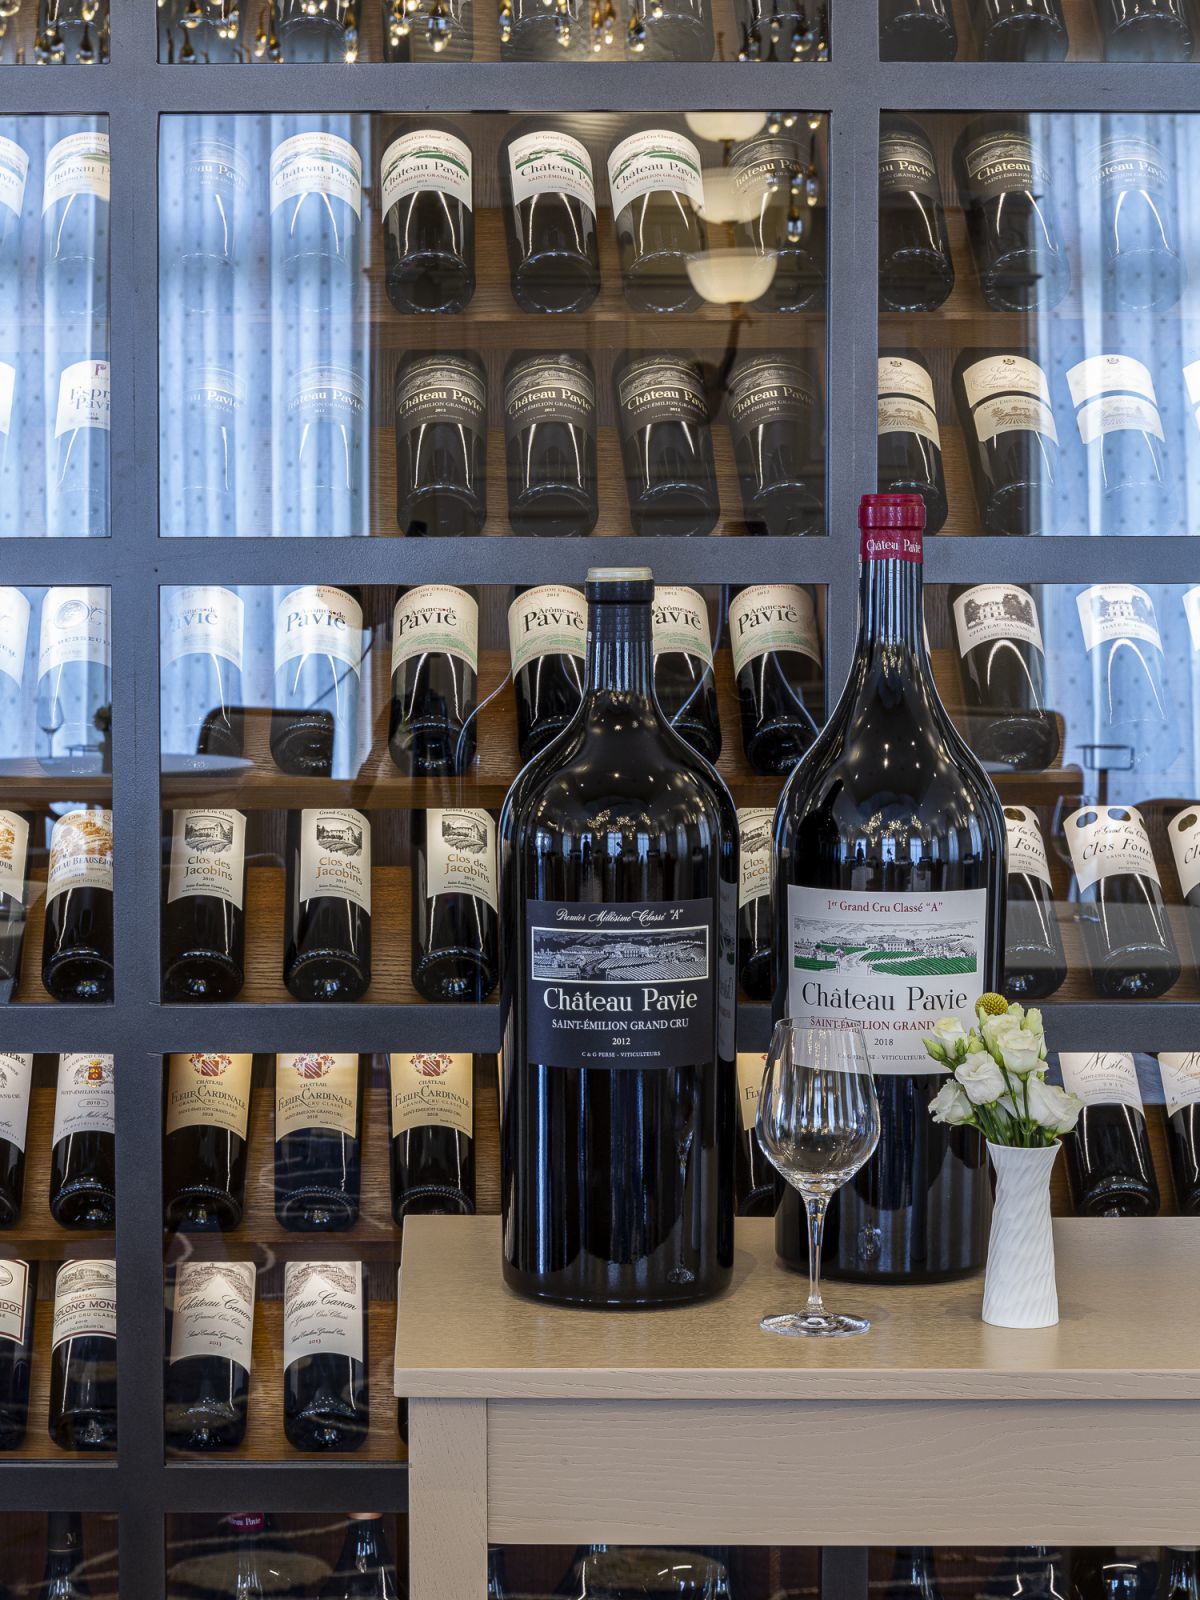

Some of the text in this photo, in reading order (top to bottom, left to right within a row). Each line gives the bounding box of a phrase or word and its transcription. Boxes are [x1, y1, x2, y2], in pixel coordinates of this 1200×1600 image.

[384, 161, 466, 192] Château Pavie
[521, 163, 574, 177] Château
[616, 161, 697, 190] Château Pavie
[898, 160, 932, 178] Pavie
[977, 162, 1031, 180] Château
[69, 387, 110, 405] Espr
[75, 397, 110, 410] Pavi
[207, 389, 240, 409] Pavie
[332, 389, 363, 410] Pavie
[400, 389, 482, 414] Château Pavie
[508, 388, 591, 415] Château Pavie
[627, 389, 680, 410] Château
[732, 390, 779, 419] Château
[445, 401, 468, 411] GRAND
[866, 538, 921, 554] Château Pavie
[431, 586, 455, 594] GRAND
[410, 606, 443, 617] Arômes
[538, 606, 583, 619] Arômes de
[655, 605, 689, 615] Arômes
[750, 604, 797, 616] Arômes de
[286, 611, 346, 633] Pavie
[399, 612, 457, 636] Pavie
[523, 611, 584, 634] Pavie
[738, 609, 800, 637] Pavie
[1013, 837, 1046, 858] Four
[1082, 838, 1152, 861] Clos Four
[50, 856, 114, 880] HATEAU BEAUSÉJO
[187, 855, 231, 870] Clos des
[319, 856, 361, 875] Clos des
[447, 854, 488, 872] Clos des
[743, 858, 765, 870] Clos
[184, 866, 233, 881] Jacobins
[315, 866, 363, 886] Jacobins
[444, 862, 490, 884] Jacobins
[742, 864, 769, 885] Jaco
[827, 899, 837, 911] 1er
[839, 901, 870, 912] Grand
[872, 902, 891, 913] Cru
[893, 902, 923, 914] Classé
[556, 908, 586, 922] Premier
[588, 908, 632, 927] Millésime
[631, 908, 666, 927] Classé
[543, 987, 698, 1012] Château Pavie
[802, 981, 968, 1011] Château Pavie
[552, 1018, 689, 1031] SAINT-ÉMILION GRAND CRU
[893, 1020, 935, 1031] GRAND
[612, 1037, 631, 1046] 2012
[874, 1038, 894, 1046] 2018
[620, 1050, 661, 1058] VITICULTEURS
[171, 1085, 246, 1110] FLEUR CARDINALE
[278, 1087, 353, 1112] FLEUR CARDINALE
[395, 1085, 470, 1109] FLEUR CARDINALE
[744, 1086, 760, 1101] FLE
[0, 1302, 21, 1314] DOT
[178, 1294, 252, 1322] Château Canon
[318, 1289, 357, 1311] Canon
[55, 1300, 116, 1320] PLONG MON
[93, 1312, 116, 1320] CLASS
[314, 1309, 328, 1318] Cru
[66, 1532, 77, 1545] M
